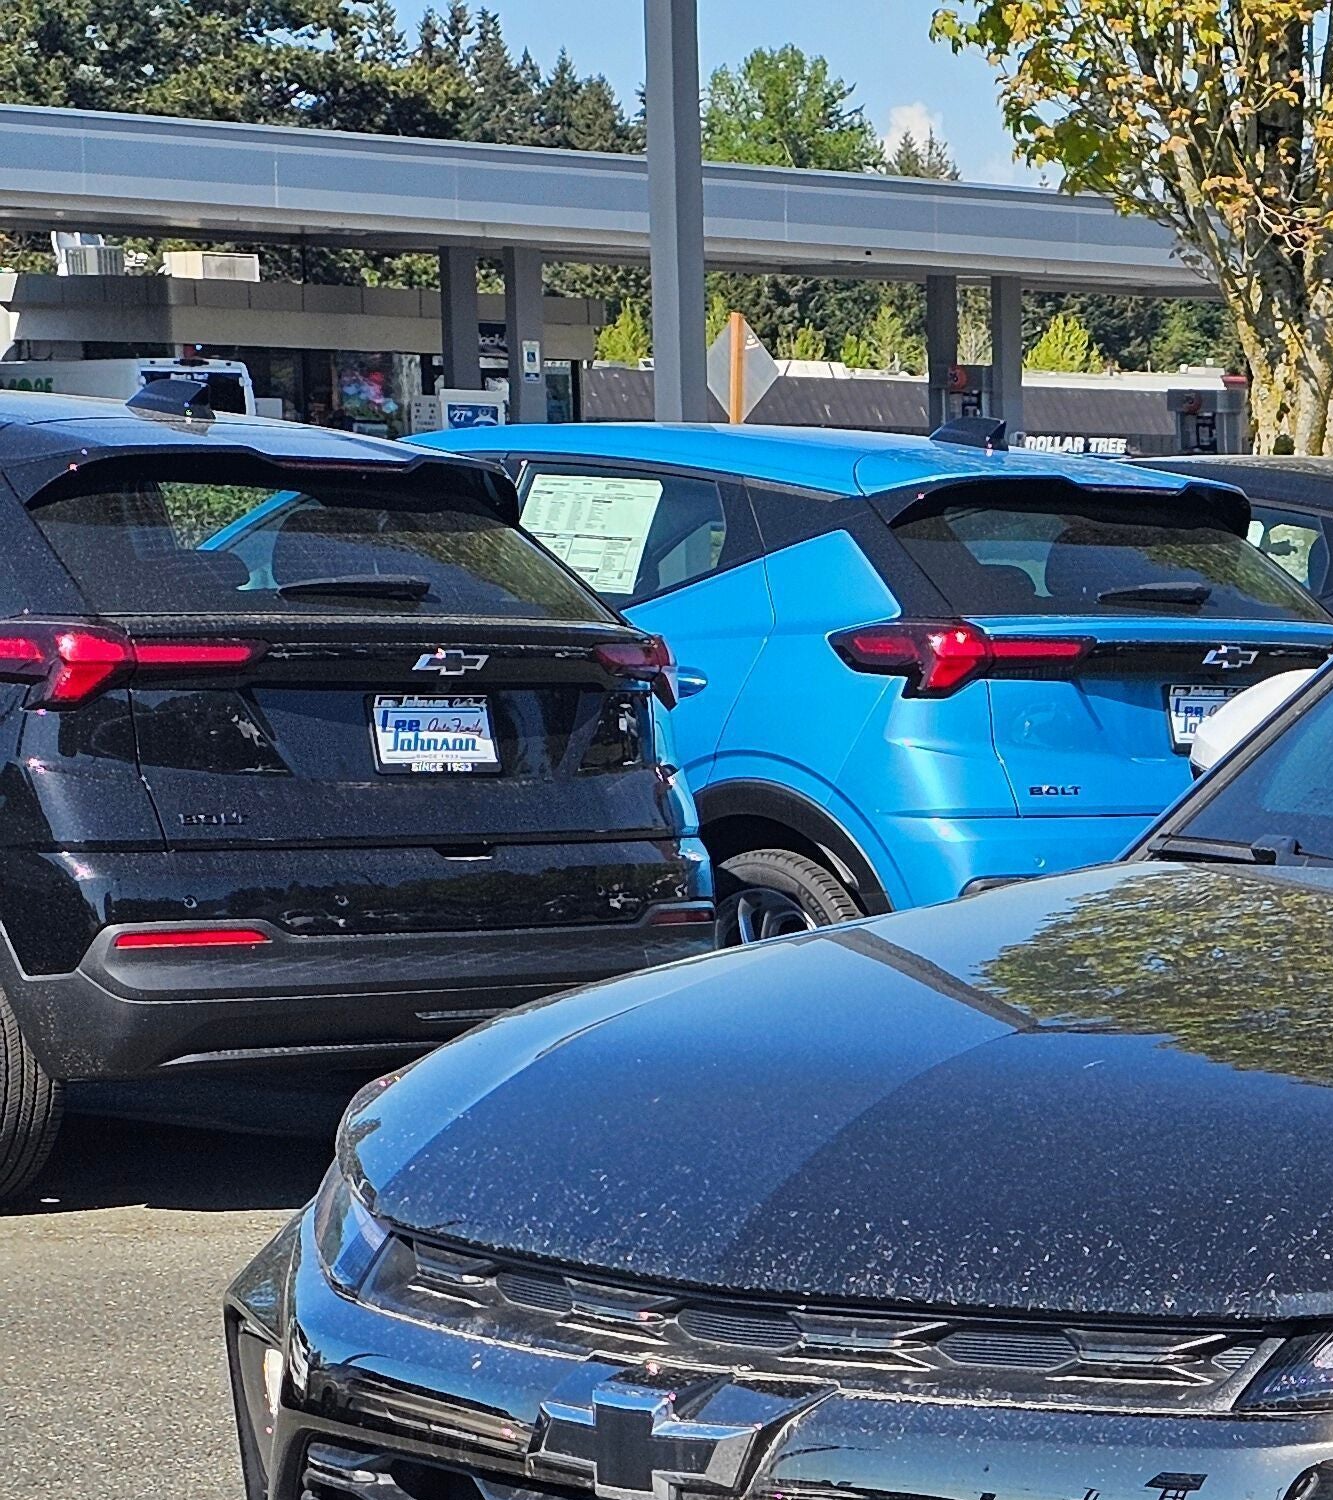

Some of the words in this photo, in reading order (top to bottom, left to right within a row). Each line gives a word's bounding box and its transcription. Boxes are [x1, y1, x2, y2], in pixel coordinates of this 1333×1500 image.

[1025, 434, 1085, 453] DOLLAR
[1087, 436, 1128, 454] TREE
[381, 709, 421, 733] Lee
[385, 729, 481, 752] Johnson
[411, 762, 444, 773] SINCE
[1029, 784, 1082, 796] BOLT
